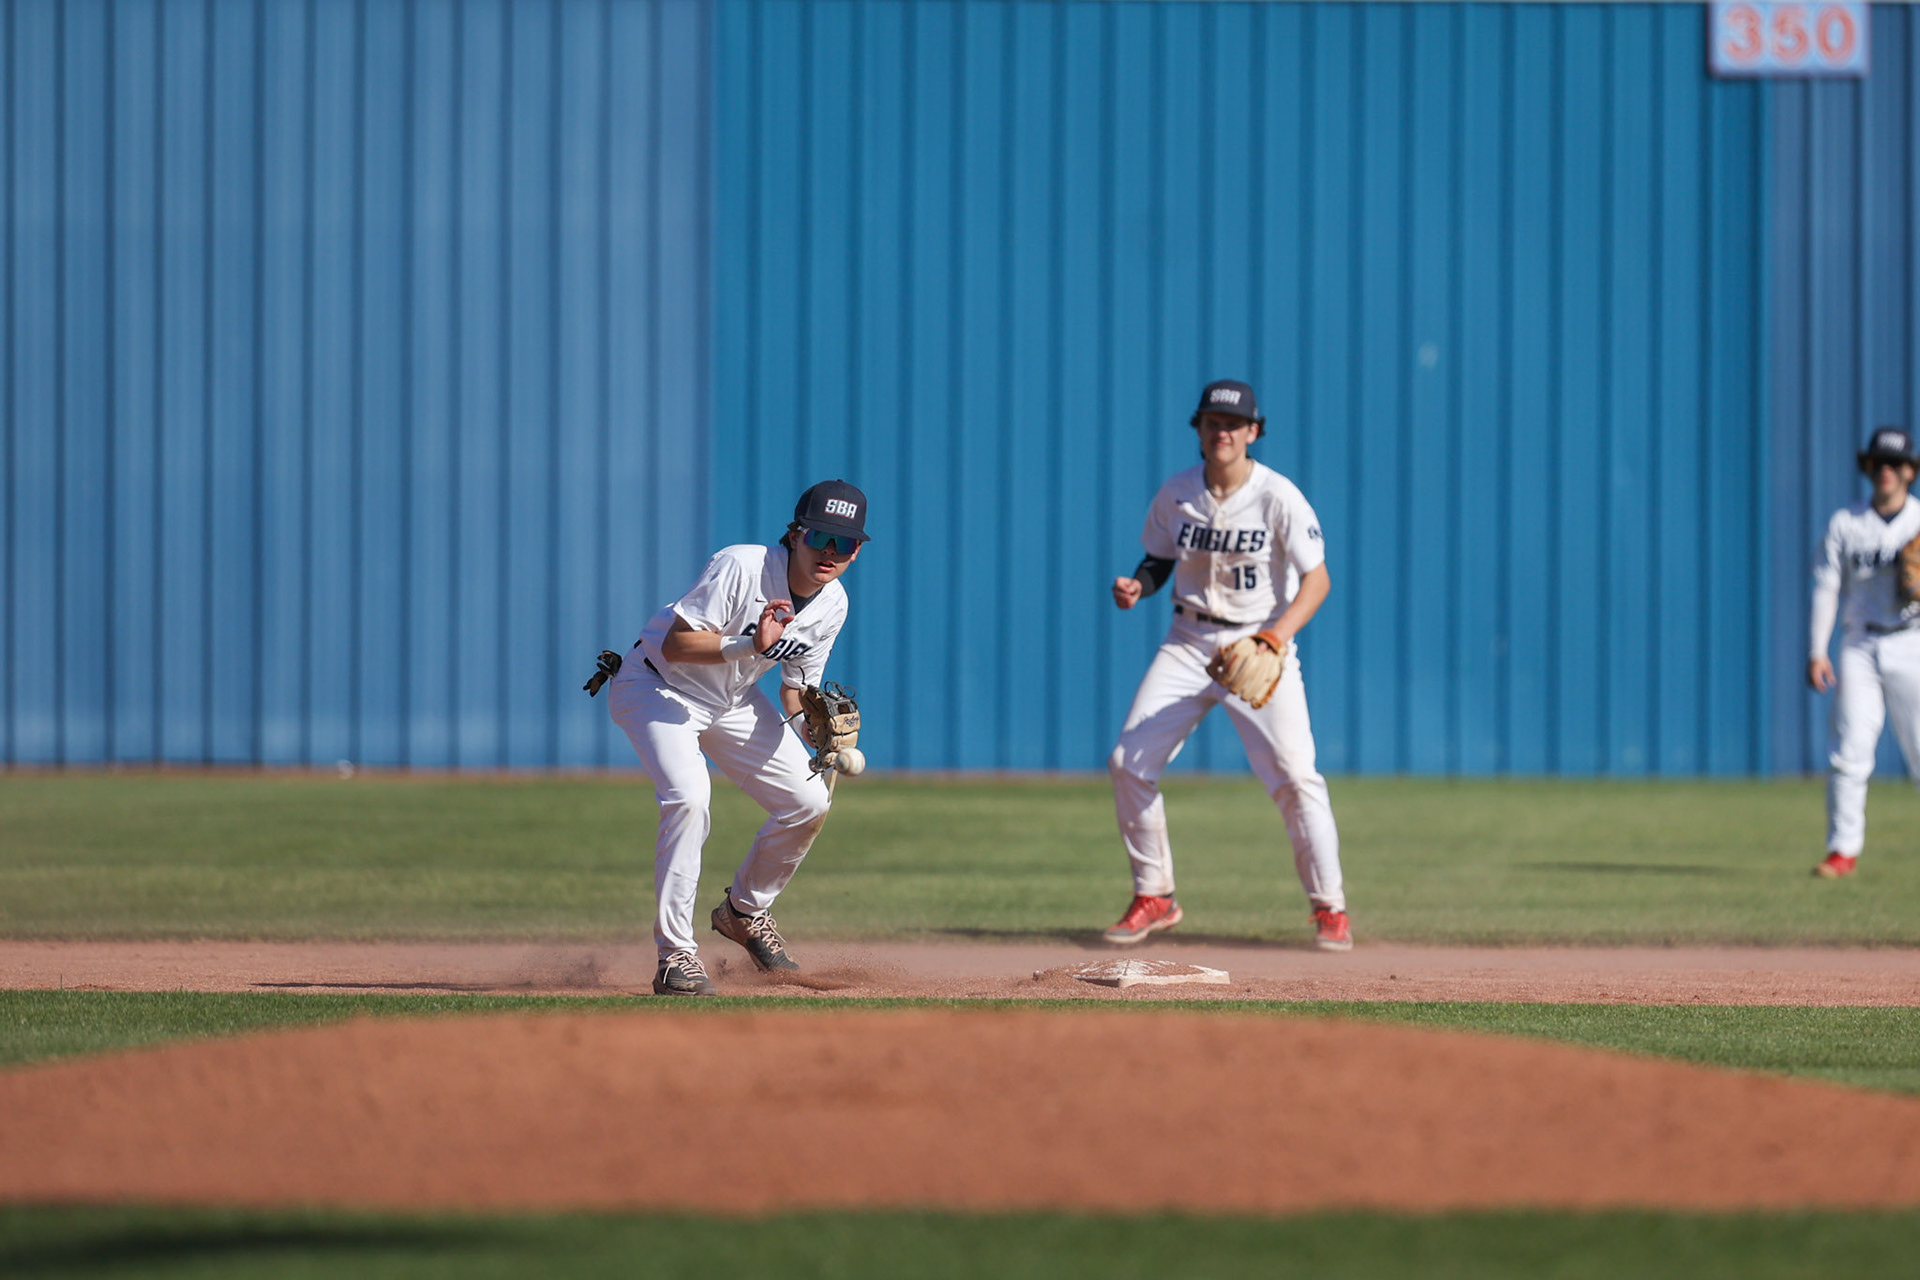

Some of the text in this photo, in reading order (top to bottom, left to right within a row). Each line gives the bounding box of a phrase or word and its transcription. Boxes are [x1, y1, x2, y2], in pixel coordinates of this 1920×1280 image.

[1723, 5, 1857, 65] 350
[824, 498, 858, 519] SBA
[1177, 522, 1266, 553] EAGLES
[1231, 564, 1257, 591] 15
